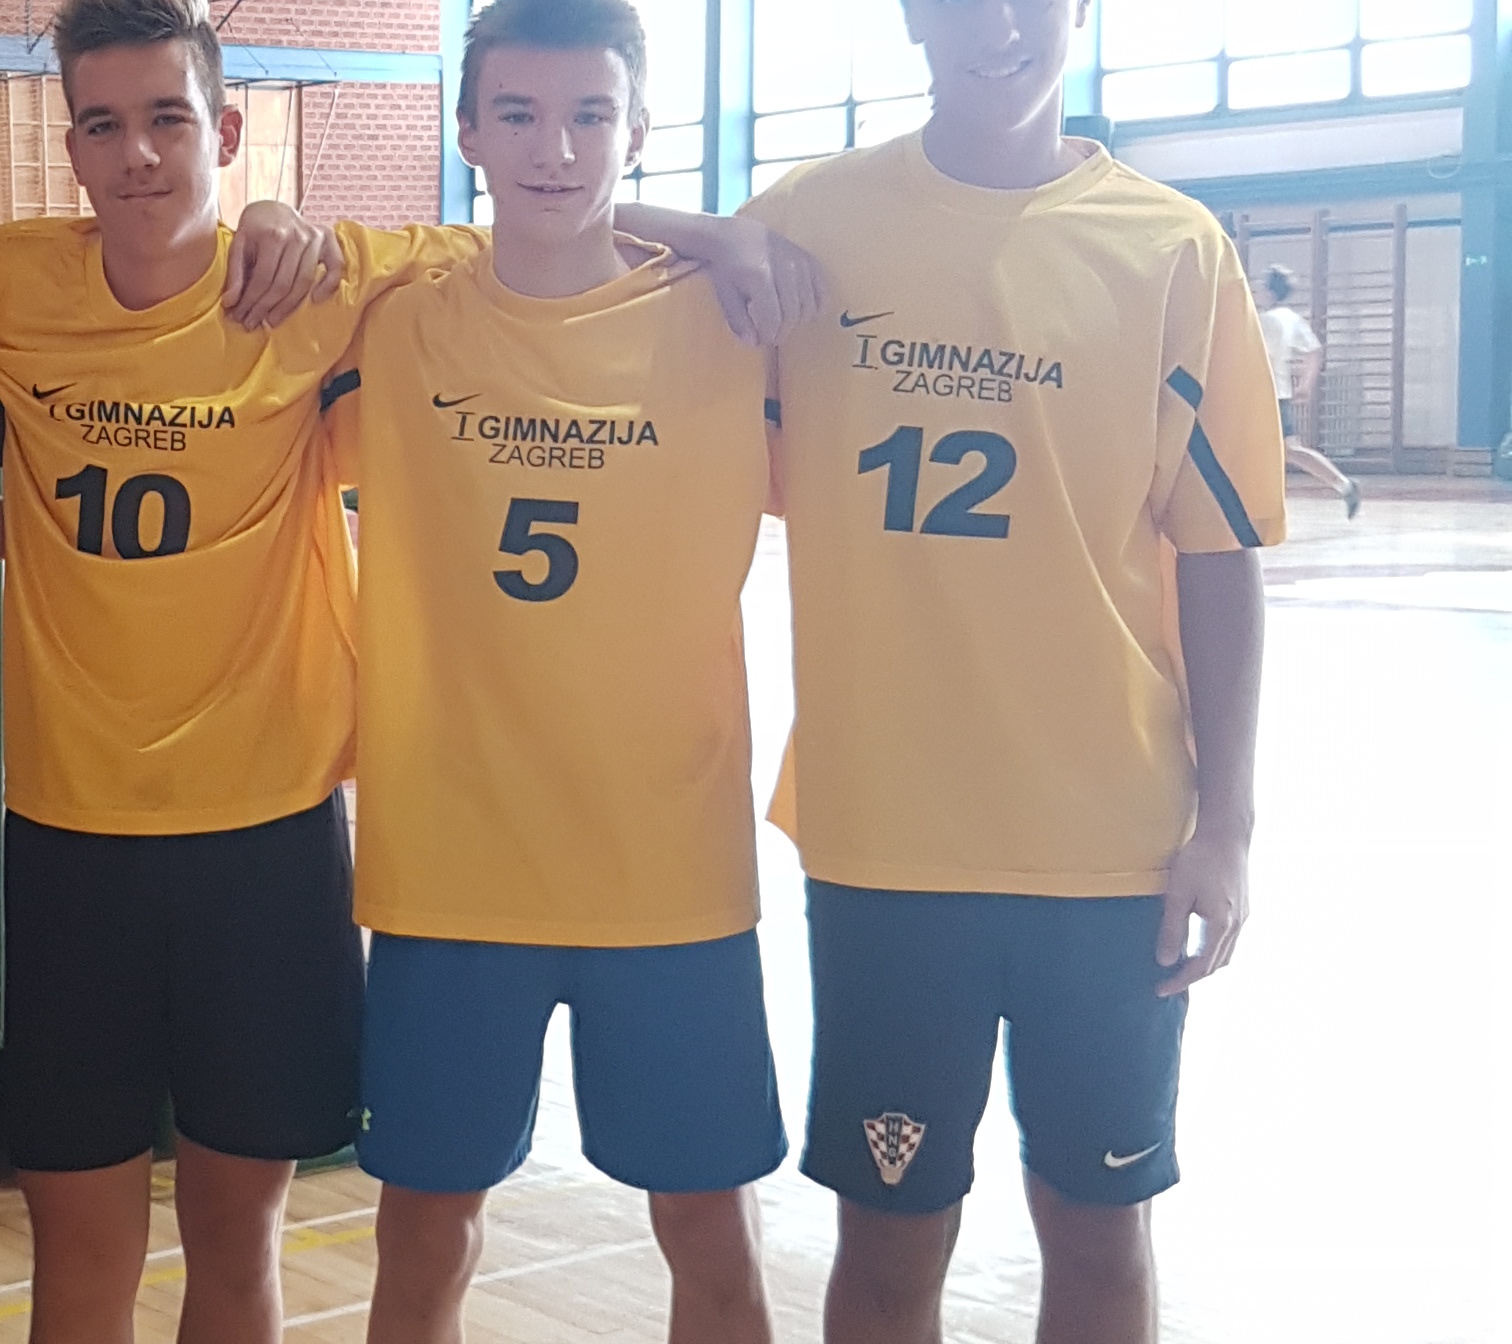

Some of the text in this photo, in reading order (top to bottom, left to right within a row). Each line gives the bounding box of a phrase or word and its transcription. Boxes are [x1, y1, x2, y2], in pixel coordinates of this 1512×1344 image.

[879, 339, 1065, 389] GIMNAZIJA
[892, 369, 1014, 404] ZAGREB
[65, 399, 236, 429] GIMNAZIJA
[478, 415, 659, 446] GIMNAZIJA
[80, 423, 187, 452] ZAGREB
[489, 443, 606, 470] ZAGREB
[857, 424, 1018, 539] 12
[54, 463, 191, 560] 10
[492, 497, 580, 603] 5
